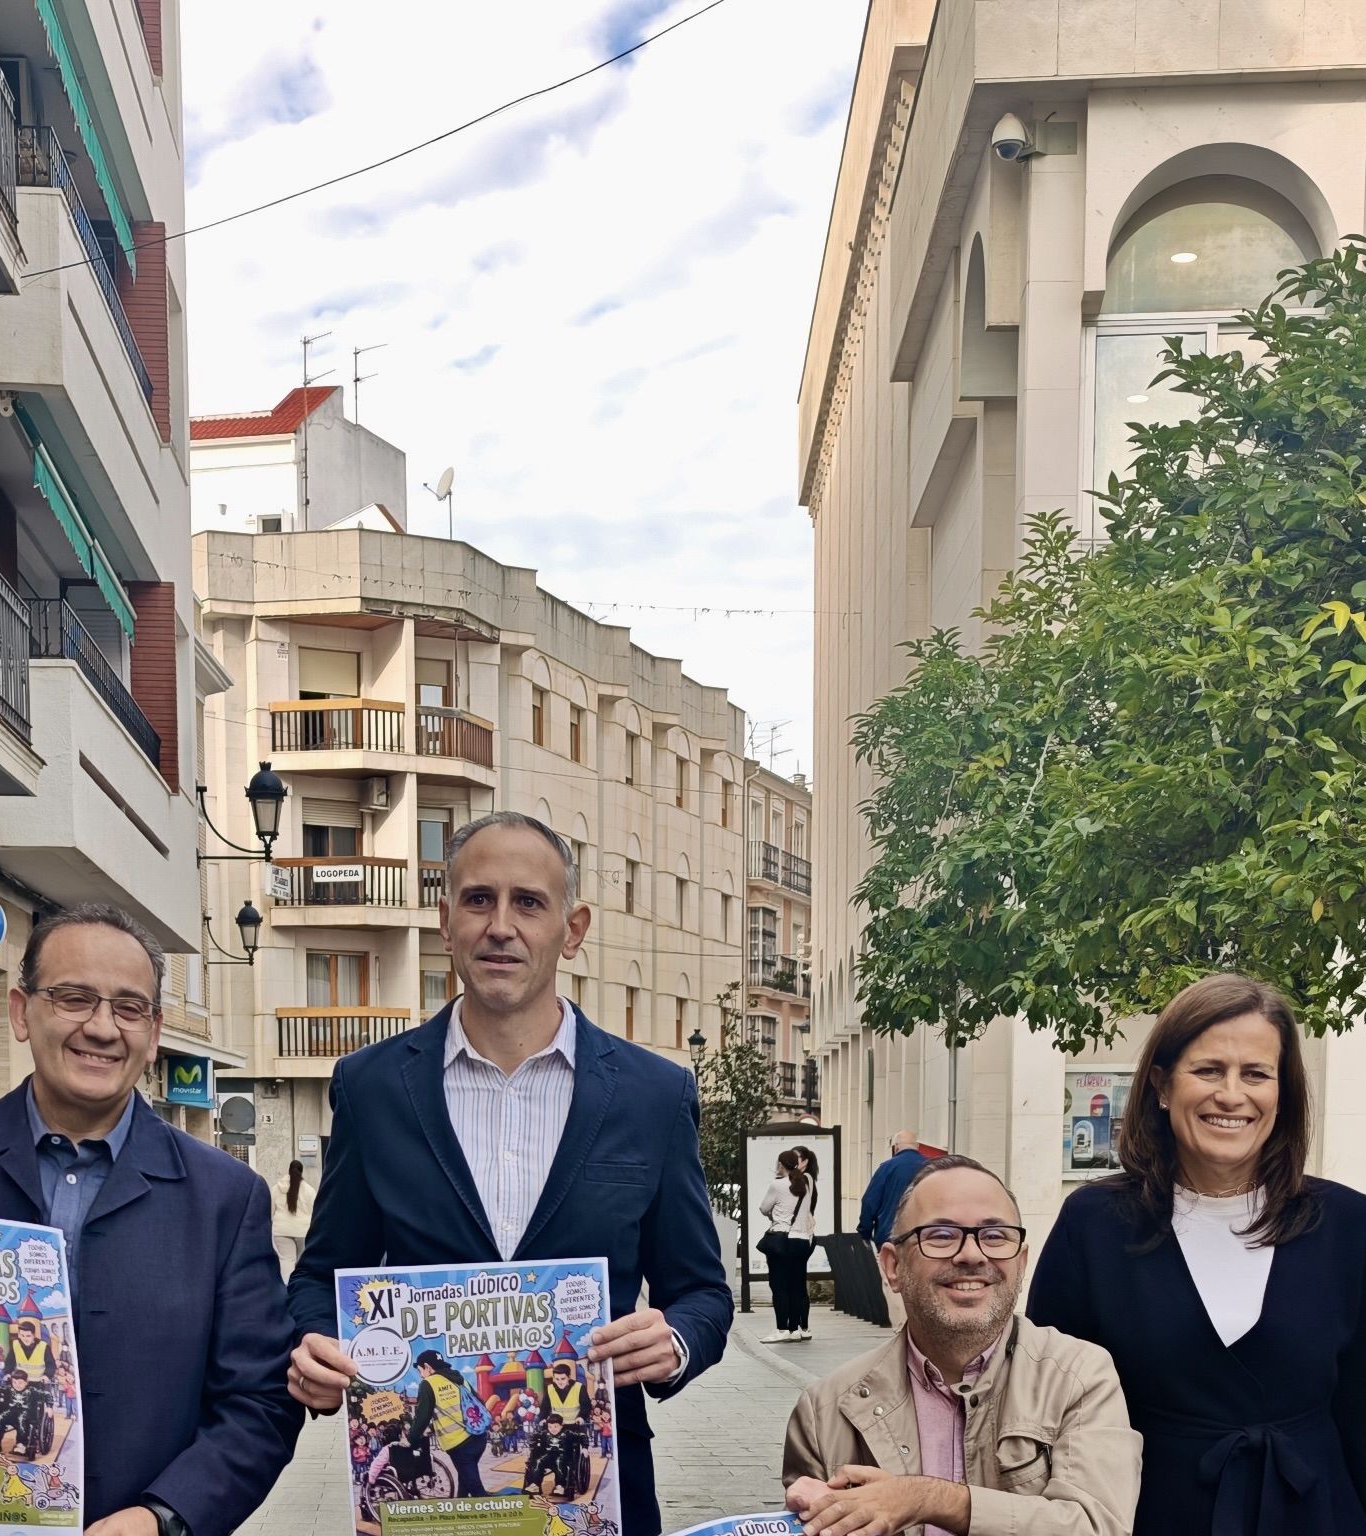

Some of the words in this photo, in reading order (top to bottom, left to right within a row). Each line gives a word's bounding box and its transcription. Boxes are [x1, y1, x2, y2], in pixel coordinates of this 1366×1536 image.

[316, 870, 359, 878] LOGOPEDA
[408, 1285, 462, 1304] Jornadas
[471, 1272, 519, 1296] LÚDICO
[448, 1331, 489, 1354] PARA
[495, 1325, 553, 1349] NIÑ@S
[386, 1503, 434, 1515] Viernes
[437, 1502, 453, 1513] 30
[456, 1501, 472, 1511] de
[475, 1499, 524, 1511] octubre
